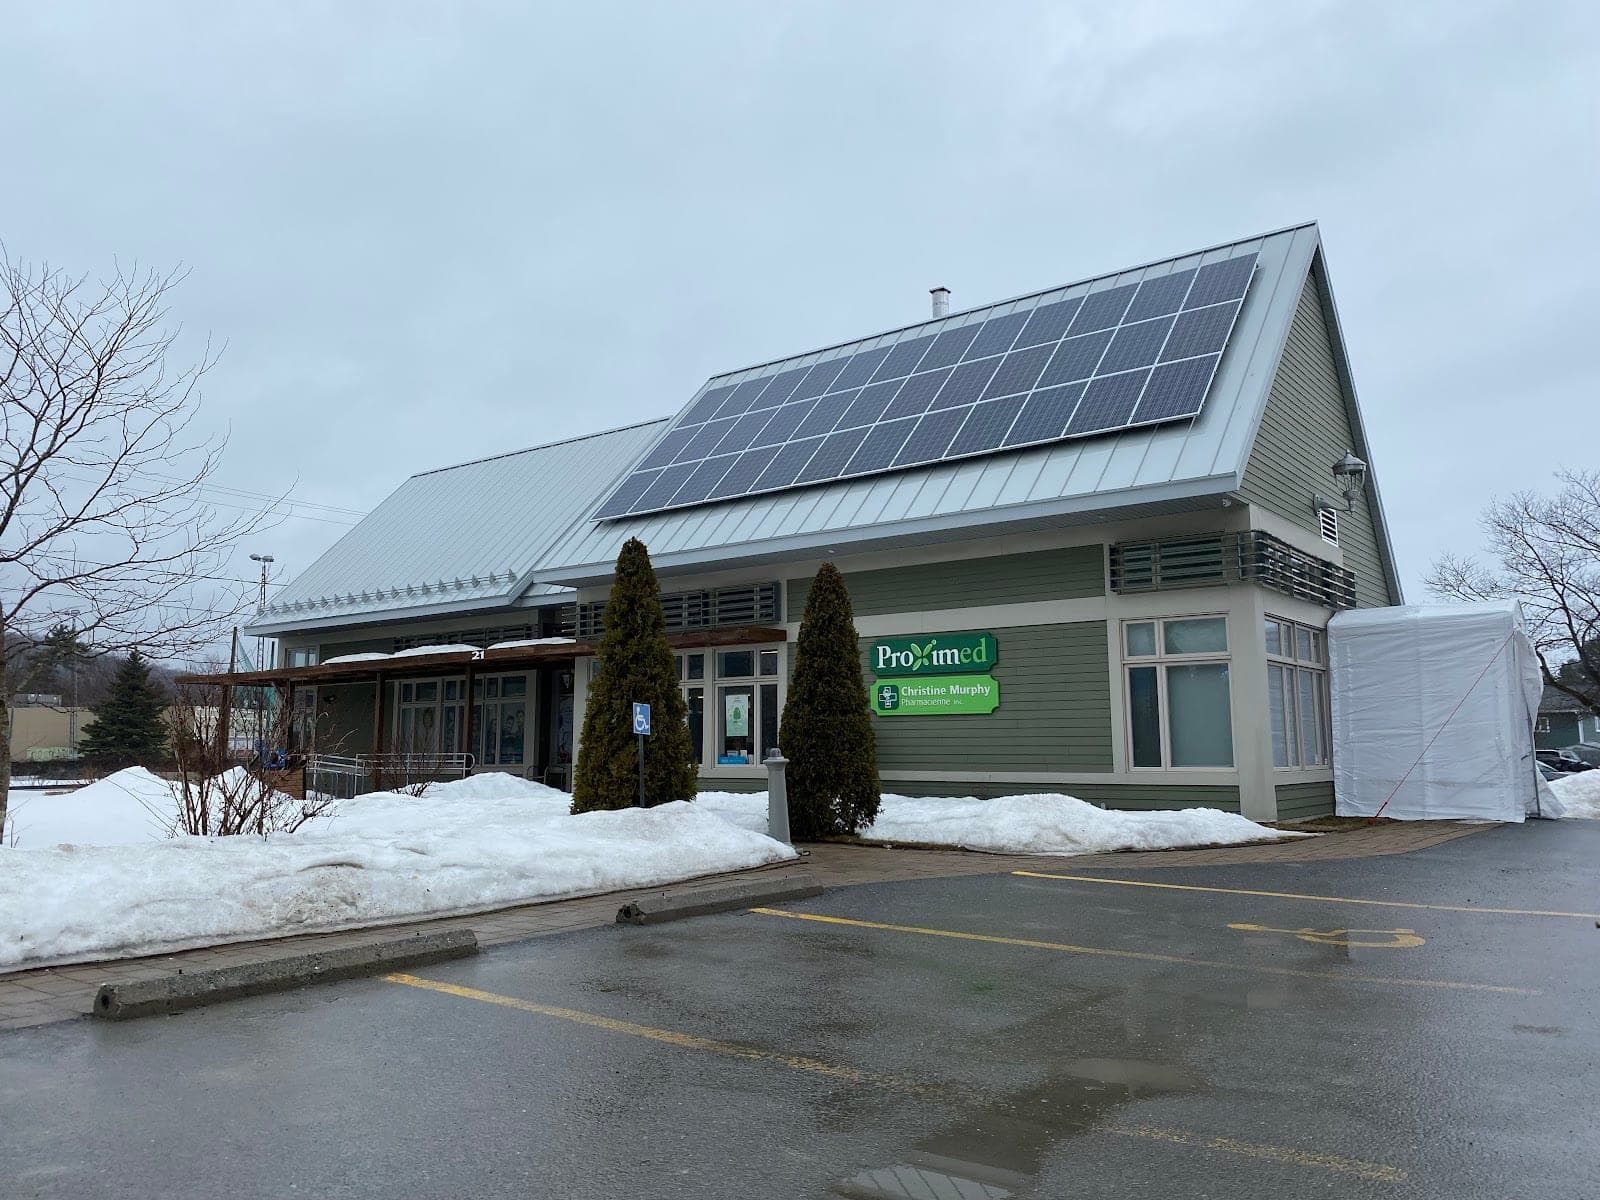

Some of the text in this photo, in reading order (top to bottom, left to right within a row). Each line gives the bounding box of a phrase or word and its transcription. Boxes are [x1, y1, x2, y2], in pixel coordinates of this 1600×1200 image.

[471, 650, 485, 660] 21
[901, 684, 991, 697] Christine Murphy
[901, 697, 951, 707] Pharmacienne
